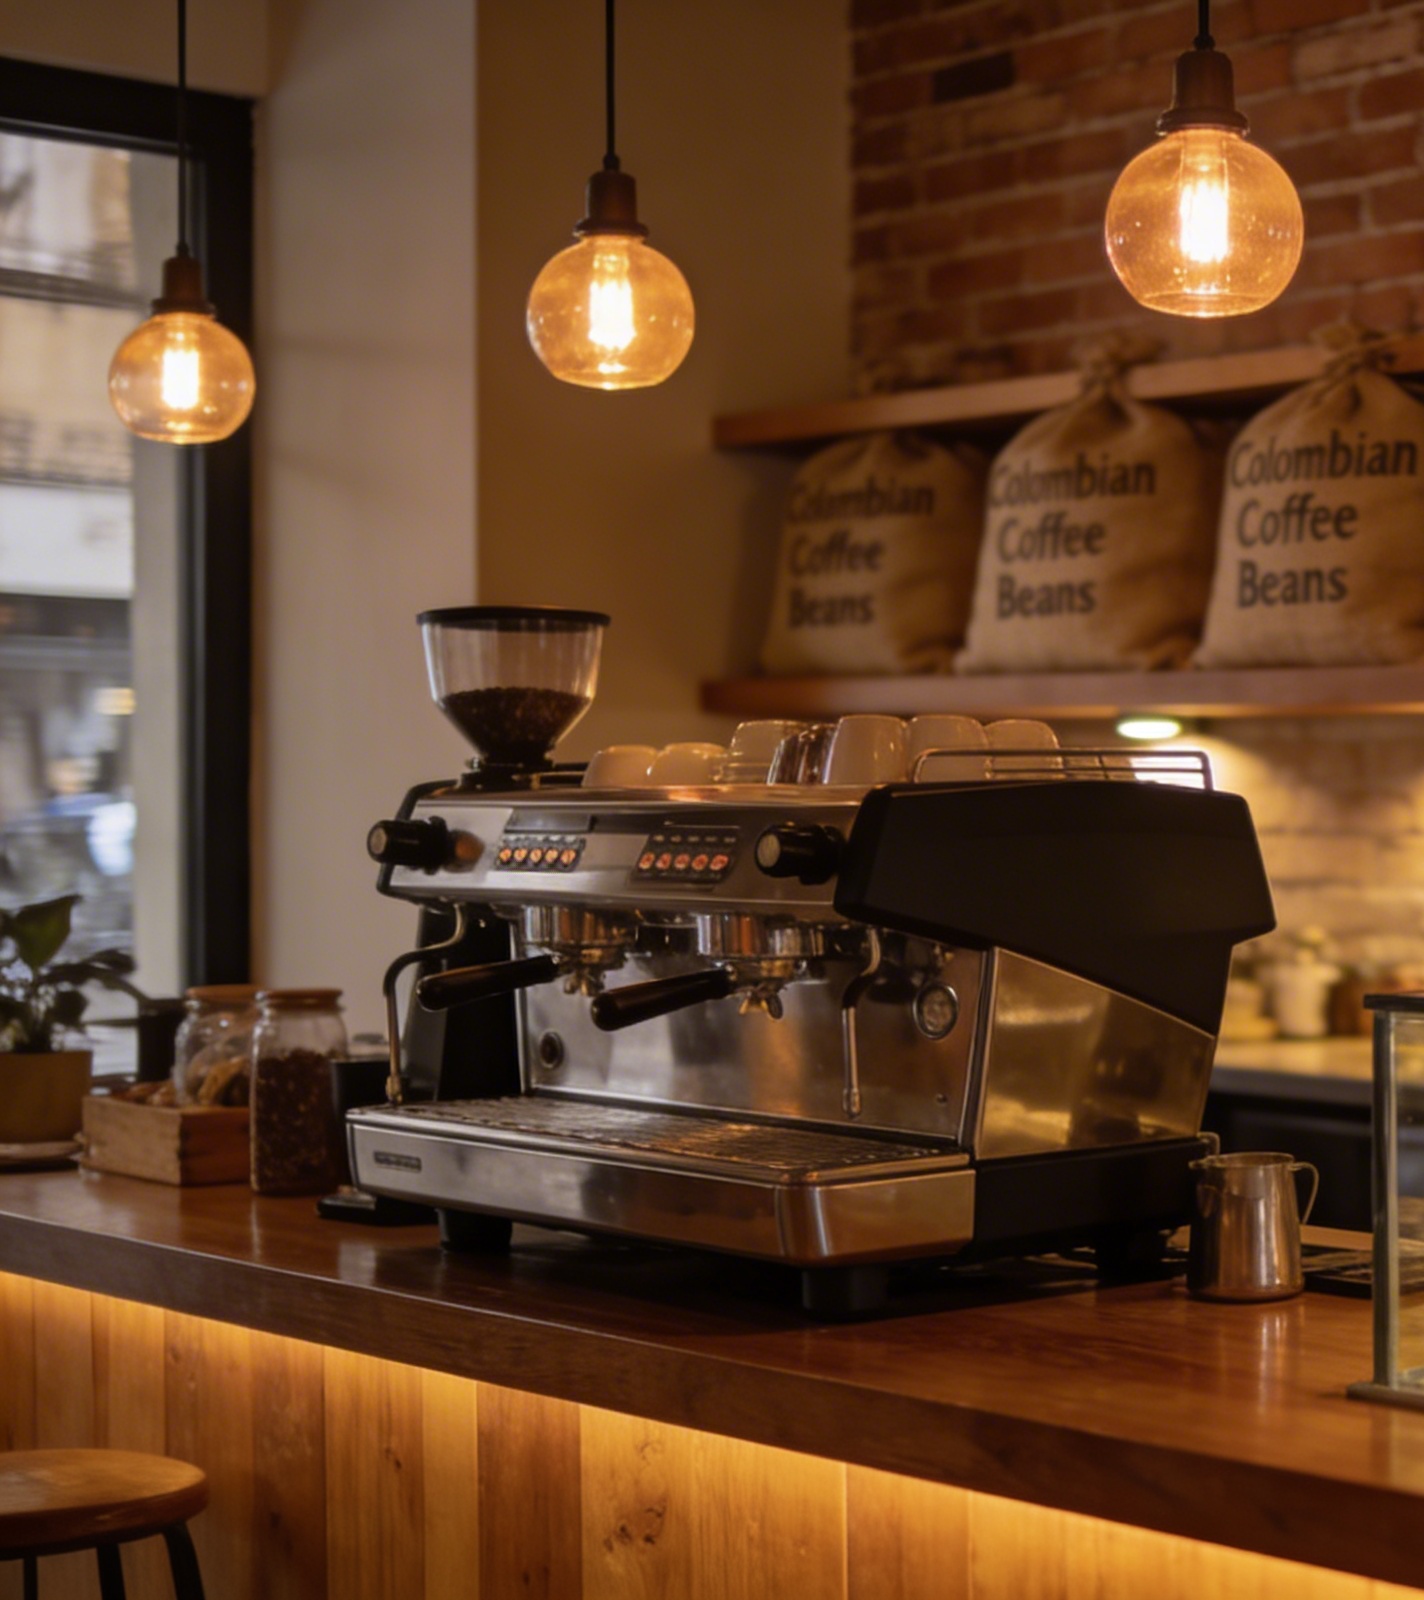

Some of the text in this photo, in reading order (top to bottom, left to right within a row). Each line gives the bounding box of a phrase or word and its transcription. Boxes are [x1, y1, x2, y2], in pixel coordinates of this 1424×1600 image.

[989, 453, 1157, 507] Colombian
[1231, 430, 1417, 488] Colombian
[998, 511, 1105, 563] Coffee
[1237, 493, 1357, 546] Coffee
[790, 530, 883, 577] Coffee
[788, 588, 875, 628] Beans
[997, 574, 1096, 619] Beans
[1237, 560, 1347, 608] Beans
